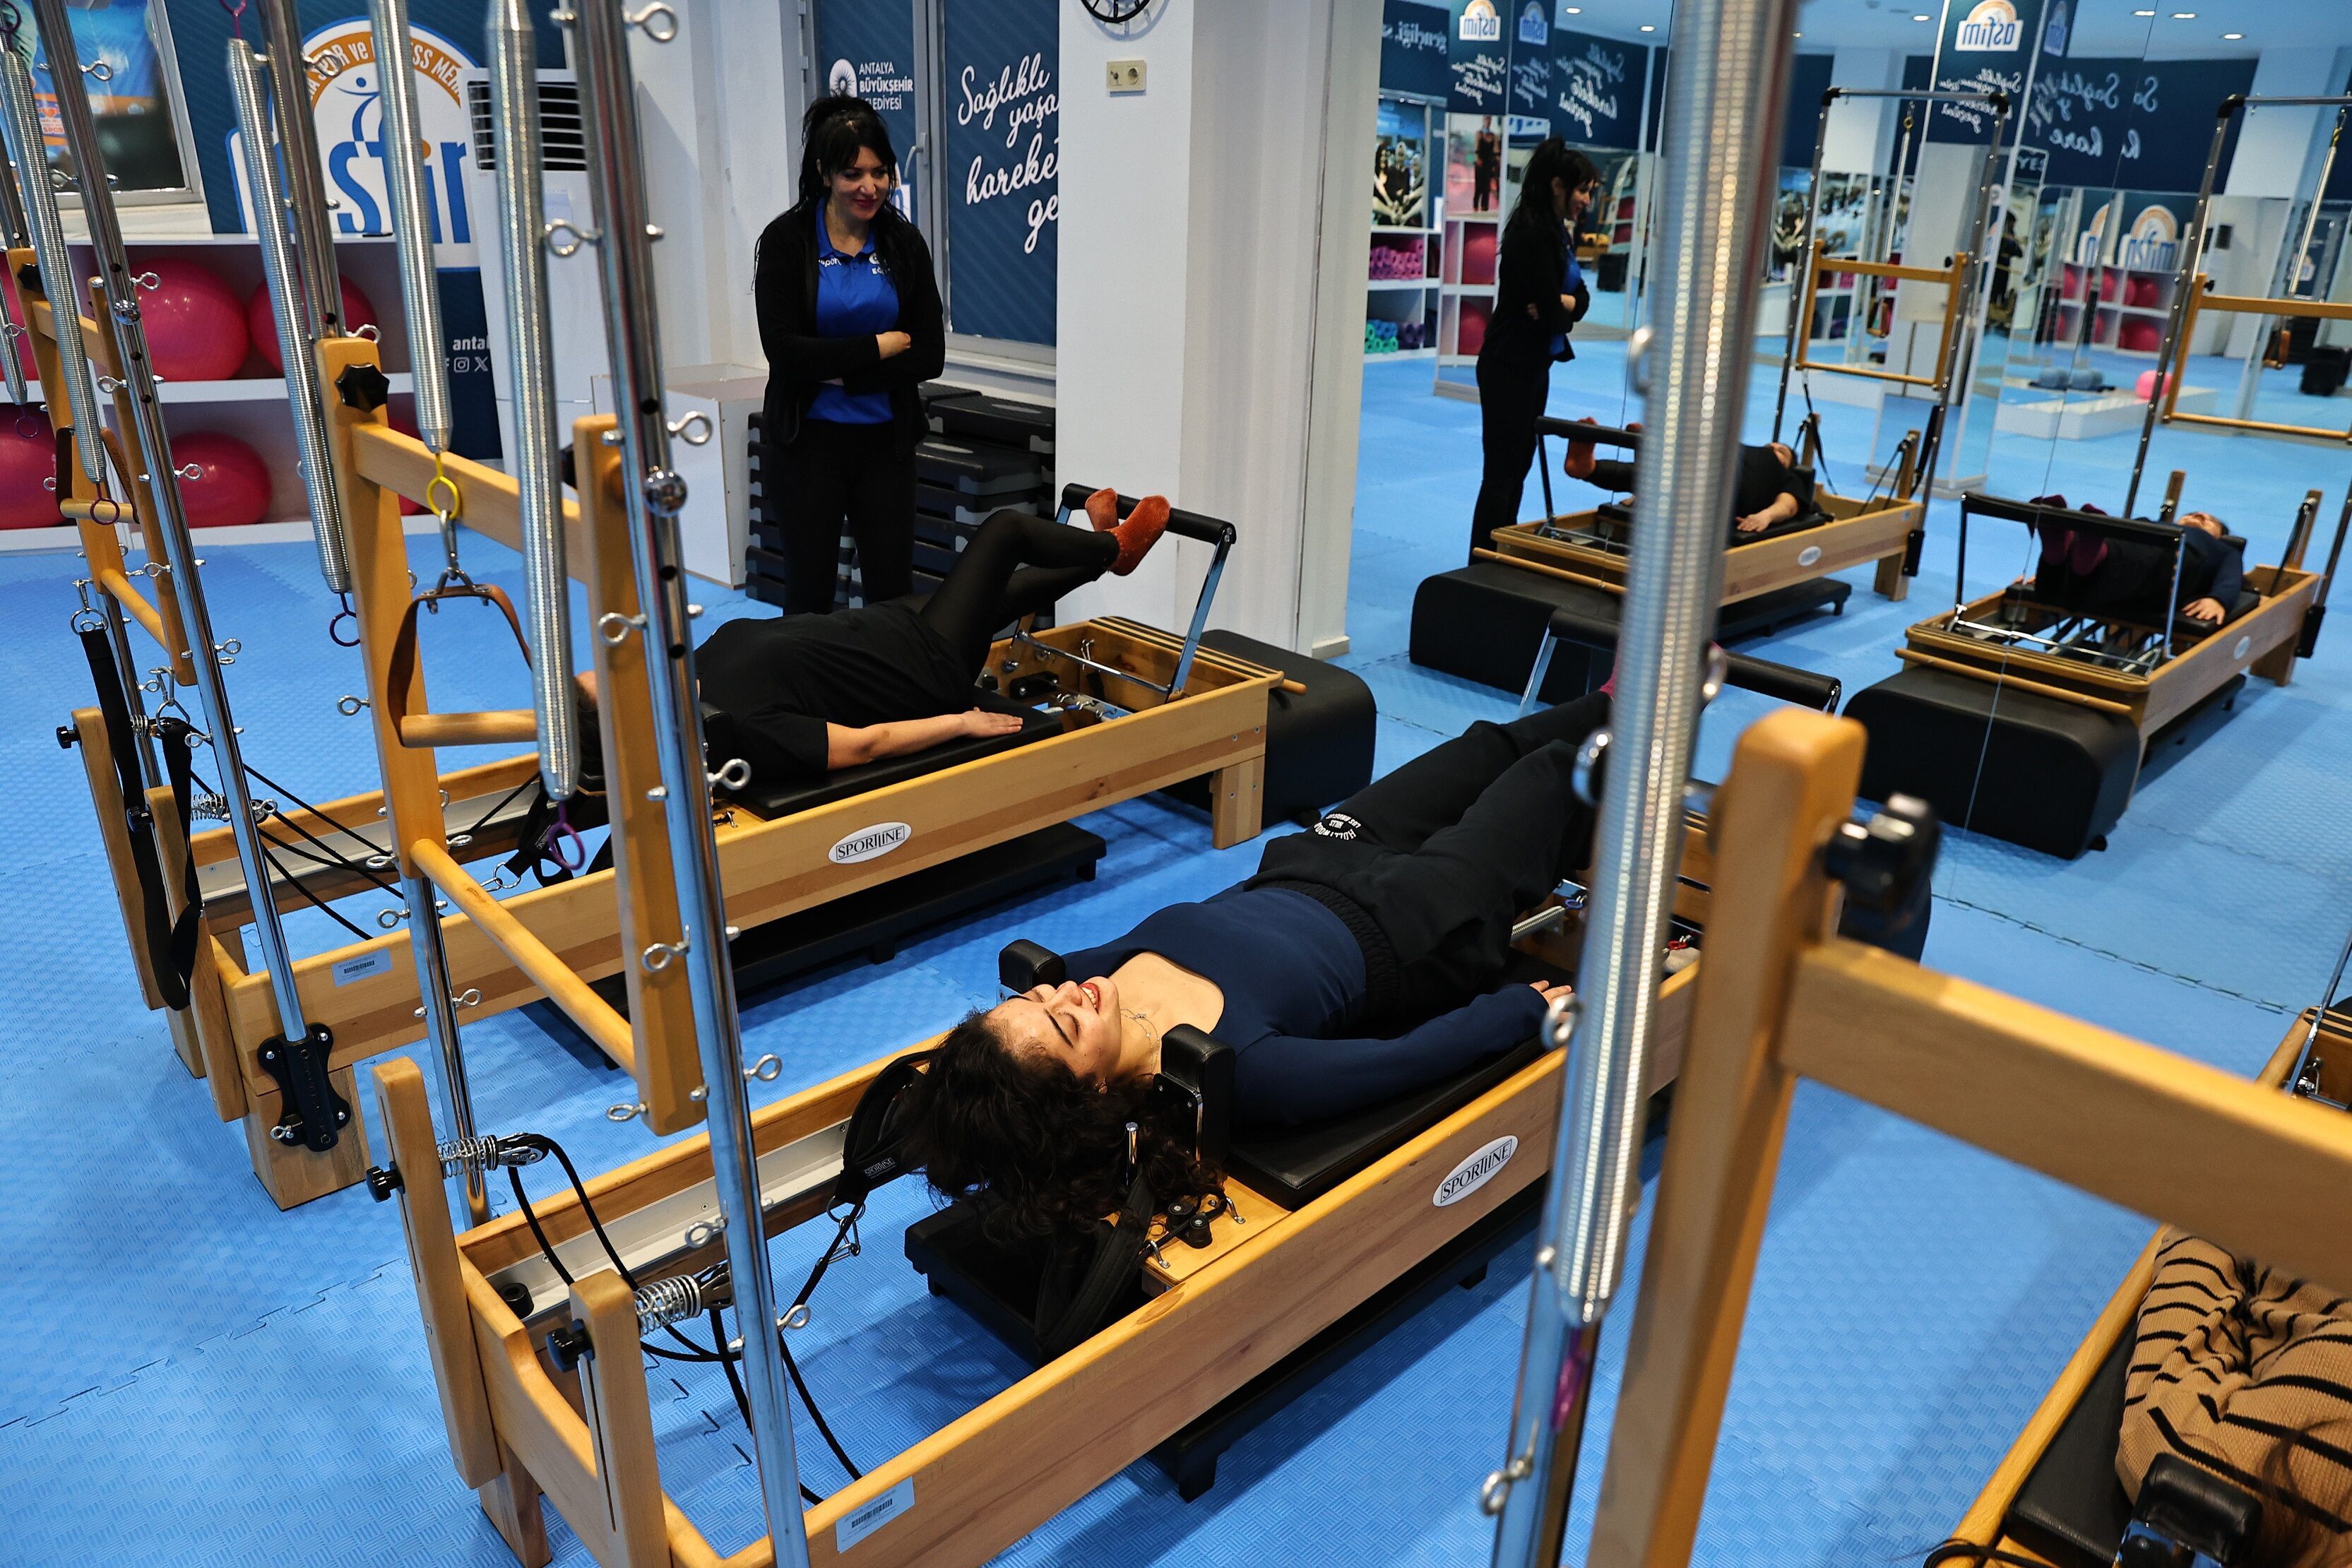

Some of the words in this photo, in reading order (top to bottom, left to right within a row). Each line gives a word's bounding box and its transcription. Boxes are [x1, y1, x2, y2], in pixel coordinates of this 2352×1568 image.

[348, 42, 369, 61] ve
[859, 61, 895, 75] ANTALYA
[859, 76, 914, 95] BÜYÜKŞEHİR
[958, 52, 1050, 131] Sağlıklı
[865, 94, 903, 111] LEDİYESİ
[1006, 95, 1059, 148] yaşa
[1024, 194, 1059, 254] ge
[838, 827, 904, 858] SPORTLINE
[1442, 1141, 1511, 1199] SPORTLINE
